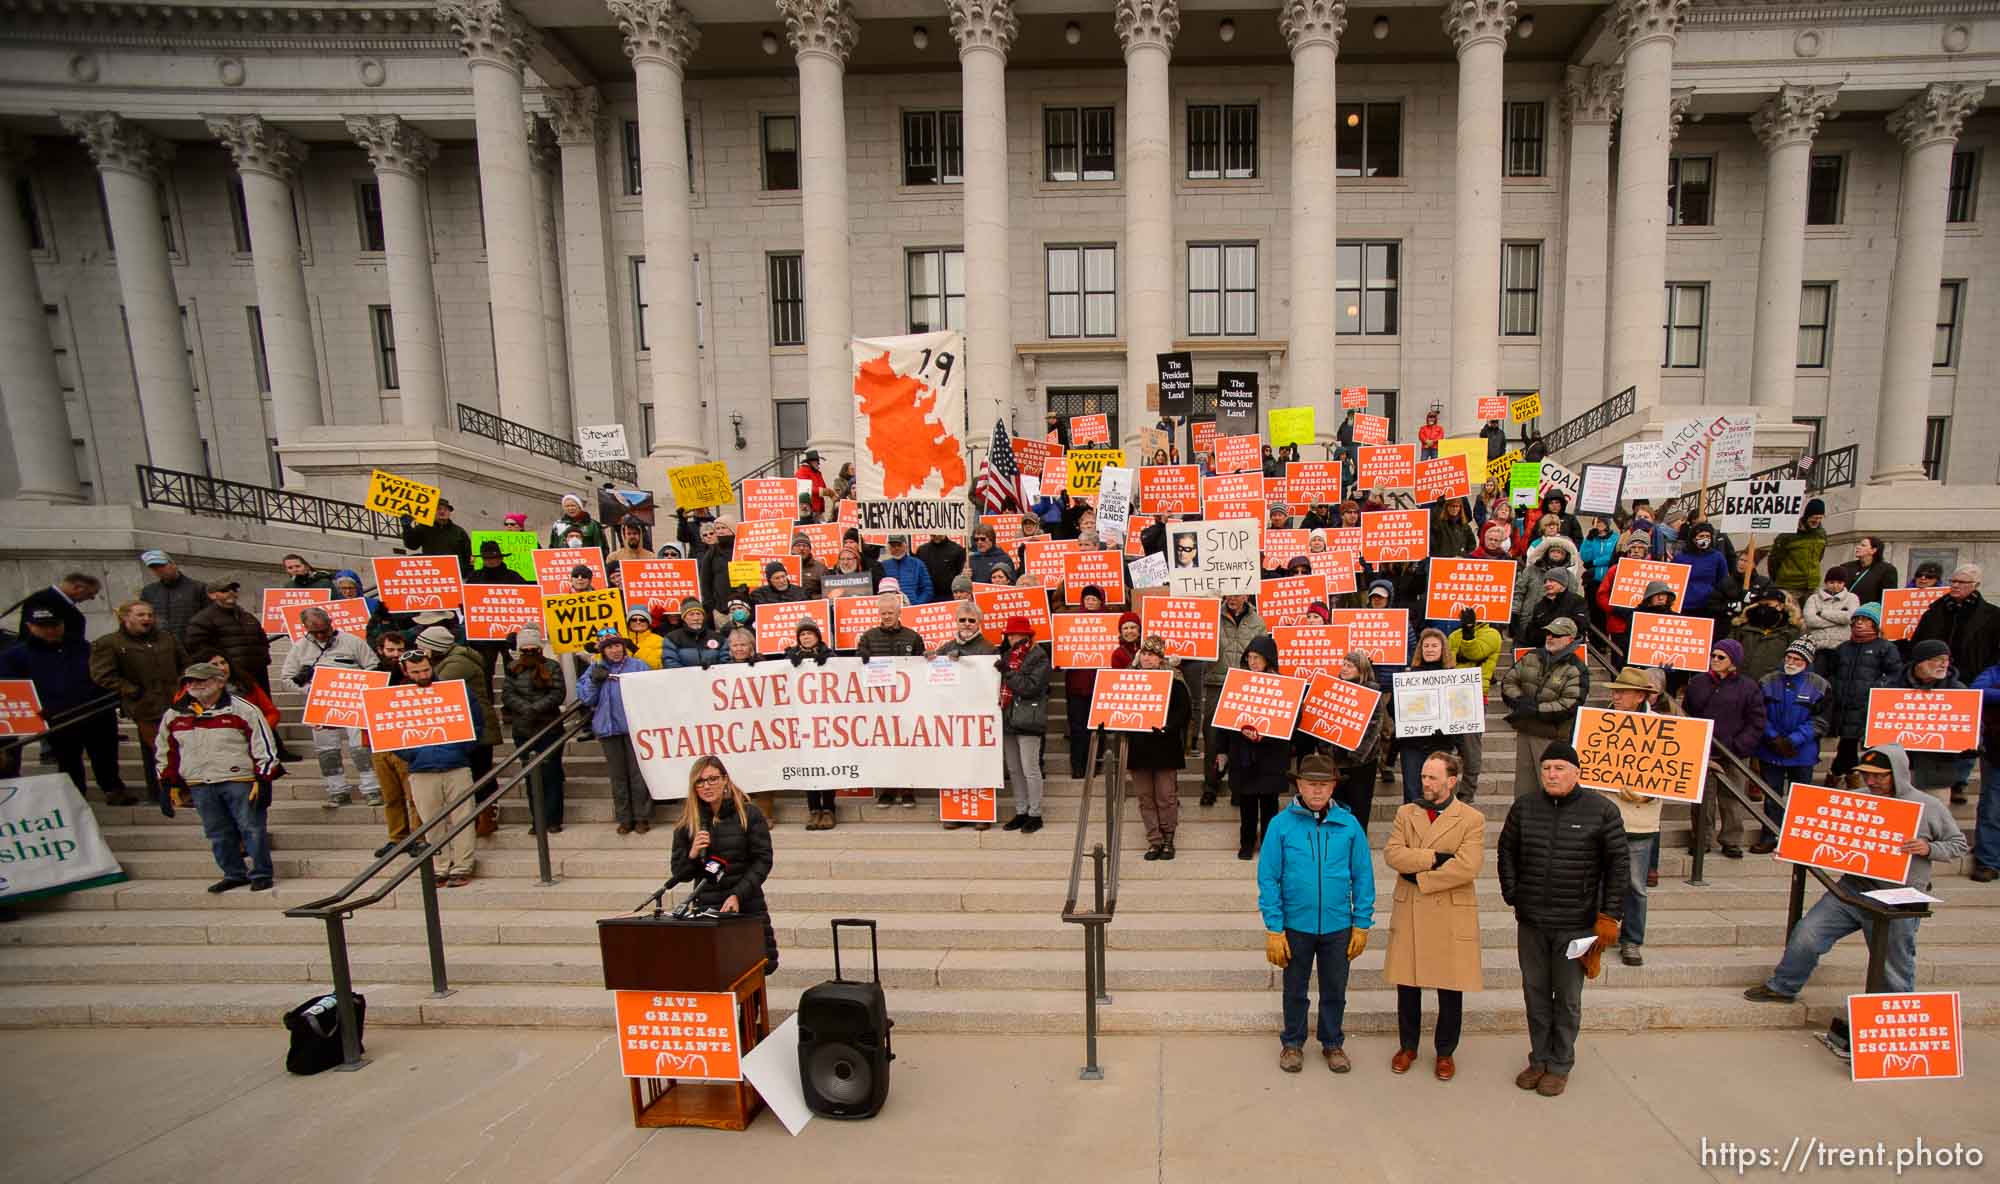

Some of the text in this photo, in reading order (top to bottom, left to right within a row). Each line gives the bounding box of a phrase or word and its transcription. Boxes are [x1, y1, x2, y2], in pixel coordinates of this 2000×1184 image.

[1168, 361, 1181, 369] The
[1162, 371, 1189, 380] President
[1161, 380, 1191, 390] Stole Your
[1230, 380, 1245, 388] The
[1167, 391, 1185, 399] Land
[1221, 389, 1253, 398] President
[1219, 399, 1254, 408] Stole Your
[1514, 400, 1537, 412] WILD
[1226, 409, 1246, 417] Land
[1515, 406, 1539, 420] UTAH
[581, 427, 620, 441] Stewart
[1662, 420, 1705, 459] HATCH
[1070, 452, 1123, 460] Protect
[1374, 447, 1397, 455] SAVE
[1370, 454, 1401, 462] GRAND
[1430, 458, 1451, 468] SAVE
[1361, 461, 1411, 470] STAIRCASE
[1426, 464, 1456, 475] GRAND
[1361, 468, 1412, 477] ESCALANTE
[1418, 469, 1465, 483] STAIRCASE
[1541, 463, 1579, 493] COAL
[1072, 475, 1101, 489] UTA
[1143, 483, 1196, 491] STAIRCASE
[1418, 476, 1466, 490] ESCALANTE
[380, 481, 430, 505] WILD
[1750, 481, 1781, 495] UN
[1143, 491, 1197, 499] ESCALANTE
[373, 494, 430, 518] UTAH
[1100, 503, 1126, 514] PUBLIC
[1725, 495, 1802, 515] BEARABLE
[1099, 512, 1124, 522] LANDS
[1381, 513, 1408, 522] SAVE
[1376, 522, 1413, 530] GRAND
[507, 535, 536, 545] LAND
[1206, 528, 1250, 552] STOP
[1365, 530, 1424, 539] STAIRCASE
[1365, 538, 1425, 547] ESCALANTE
[399, 559, 433, 568] SAVE
[1455, 562, 1489, 571] SAVE
[395, 569, 441, 577] GRAND
[639, 571, 681, 579] GRAND
[1448, 572, 1494, 582] GRAND
[384, 577, 456, 587] STAIRCASE
[628, 579, 694, 588] STAIRCASE
[1180, 576, 1252, 593] THEFT!
[1433, 582, 1508, 593] STAIRCASE
[386, 586, 459, 596] ESCALANTE
[487, 587, 518, 595] SAVE
[628, 588, 696, 596] ESCALANTE
[481, 596, 525, 604] GRAND
[547, 591, 616, 608] Protect
[1432, 592, 1508, 603] ESCALANTE
[469, 605, 539, 613] STAIRCASE
[1166, 601, 1196, 610] SAVE
[554, 603, 613, 625] WILD
[1159, 611, 1201, 620] GRAND
[1074, 616, 1103, 624] SAVE
[1657, 617, 1688, 626] SAVE
[1069, 625, 1108, 633] GRAND
[1146, 621, 1214, 631] STAIRCASE
[1650, 625, 1693, 635] GRAND
[1296, 628, 1326, 637] SAVE
[1290, 638, 1332, 647] GRAND
[1636, 632, 1706, 646] STAIRCASE
[1277, 647, 1344, 657] STAIRCASE
[1634, 641, 1706, 654] ESCALANTE
[1119, 673, 1149, 682] SAVE
[1248, 674, 1280, 687] SAVE
[1394, 673, 1481, 688] BLACK MONDAY SALE
[711, 673, 791, 711] SAVE
[1111, 682, 1153, 691] GRAND
[1240, 683, 1283, 697] GRAND
[1331, 681, 1359, 697] SAVE
[388, 695, 444, 708] GRAND
[1098, 692, 1164, 702] STAIRCASE
[1225, 691, 1294, 710] STAIRCASE
[1323, 690, 1359, 709] GRAND
[1902, 692, 1945, 701] SAVE
[373, 703, 462, 721] STAIRCASE
[1095, 701, 1164, 712] ESCALANTE
[1221, 700, 1292, 720] ESCALANTE
[1310, 697, 1365, 723] STAIRCASE
[1893, 702, 1953, 711] GRAND
[374, 713, 466, 731] ESCALANTE
[1306, 706, 1362, 732] ESCALANTE
[1874, 711, 1972, 722] STAIRCASE
[1420, 725, 1433, 733] OFF
[1466, 722, 1481, 731] OFF
[1597, 711, 1679, 741] SAVE
[1872, 721, 1973, 732] ESCALANTE
[636, 714, 997, 761] STAIRCASE-ESCALANTE
[1587, 732, 1681, 757] GRAND
[1578, 749, 1694, 781] STAIRCASE
[782, 763, 860, 781] gsenm.org
[1578, 766, 1688, 794] ESCALANTE
[1827, 793, 1879, 811] SAVE
[1815, 804, 1886, 826] GRAND
[1792, 813, 1906, 843] STAIRCASE
[652, 996, 698, 1008] SAVE
[1881, 998, 1921, 1010] SAVE
[644, 1010, 708, 1022] GRAND
[1873, 1012, 1930, 1024] GRAND
[626, 1024, 730, 1038] STAIRCASE
[1857, 1025, 1949, 1039] STAIRCASE
[627, 1038, 732, 1052] ESCALANTE
[1857, 1039, 1951, 1053] ESCALANTE
